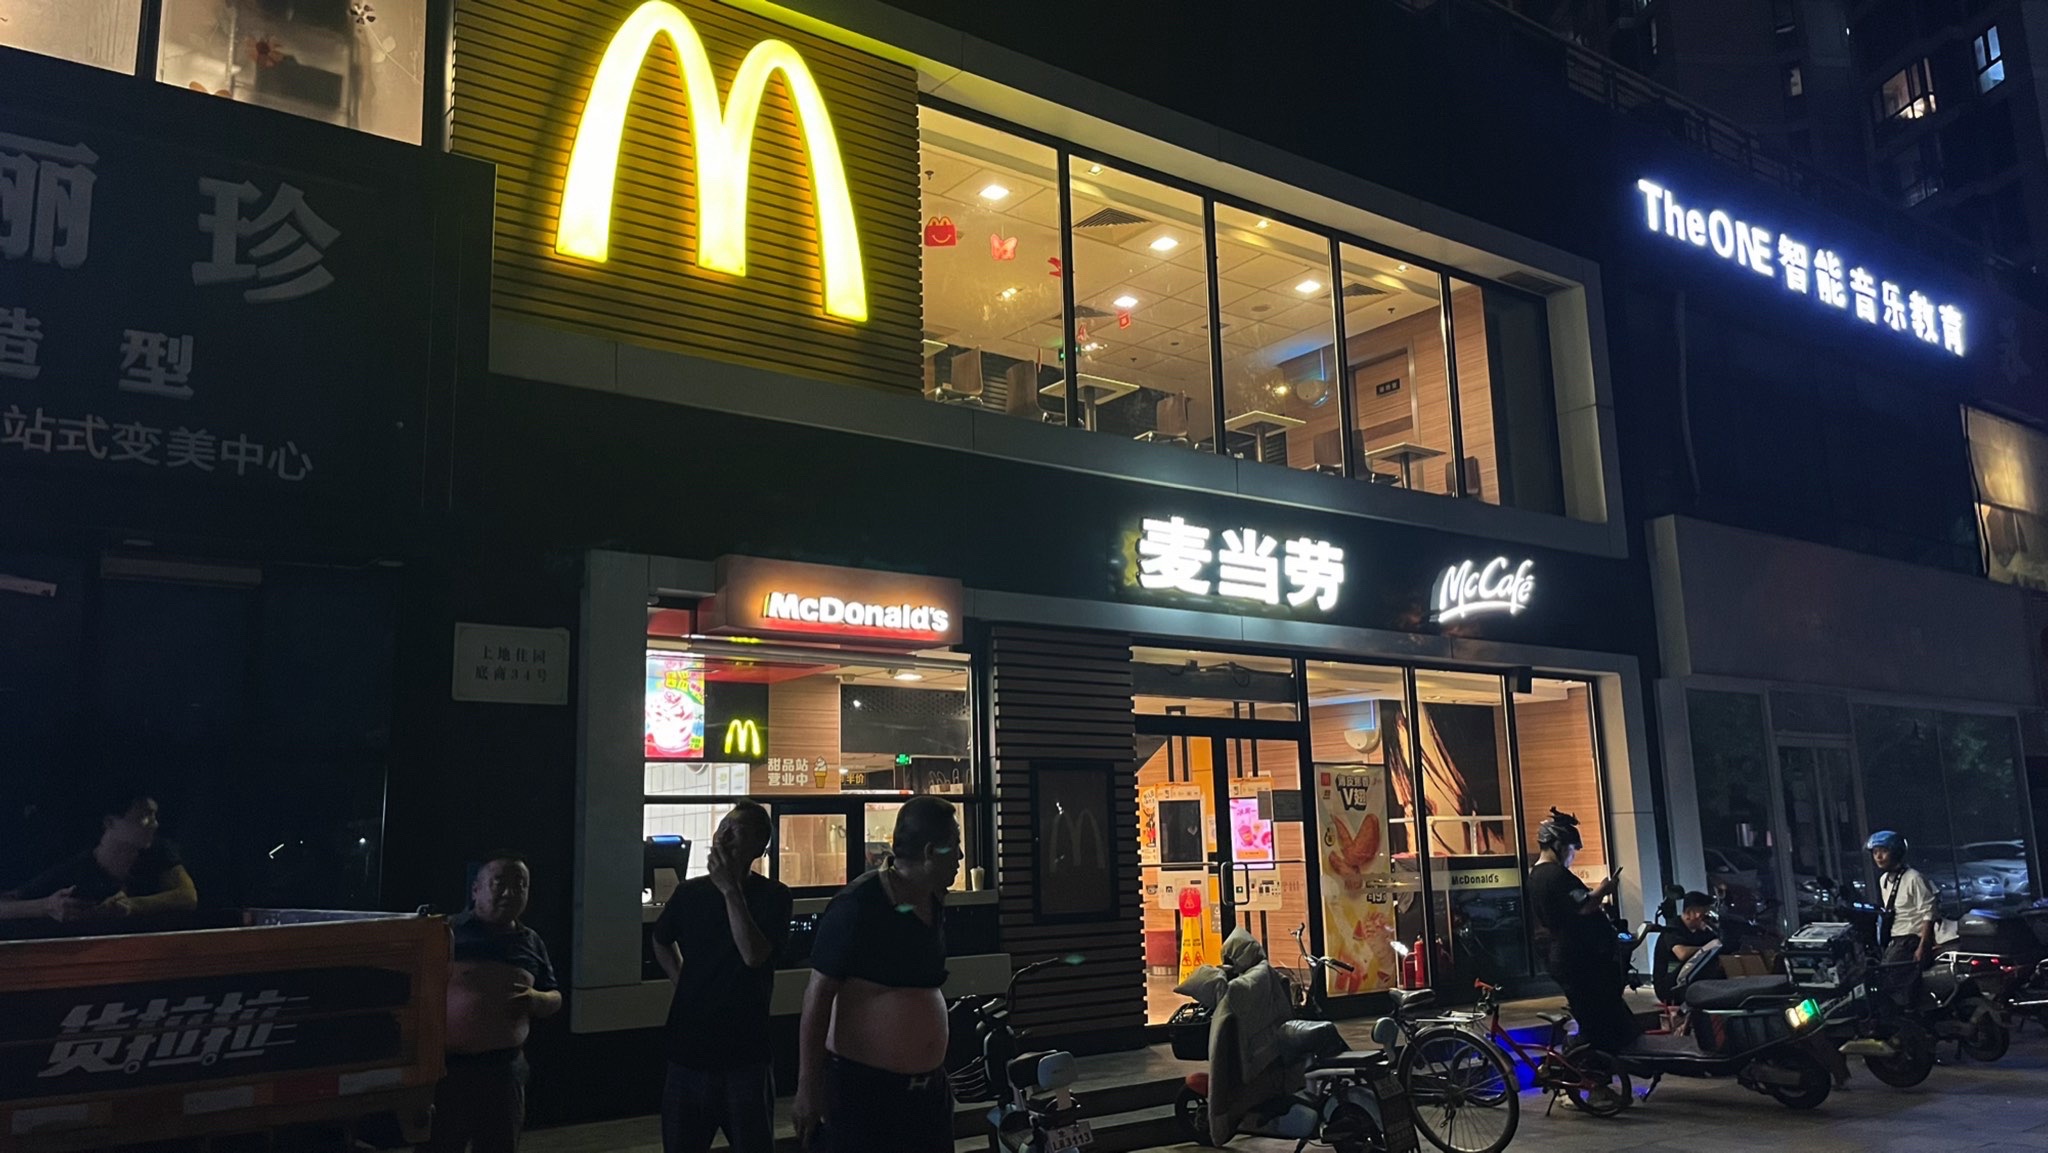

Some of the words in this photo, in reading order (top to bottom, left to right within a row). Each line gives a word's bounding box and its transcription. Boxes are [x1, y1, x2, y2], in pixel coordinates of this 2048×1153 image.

[1637, 178, 1775, 277] TheONE
[1777, 233, 1966, 357] 智能音乐教育
[1, 404, 314, 482] 站式变美中心
[1138, 516, 1345, 611] 麦当劳
[1438, 556, 1535, 618] McCafé
[765, 591, 949, 633] McDonald's
[767, 757, 809, 772] 甜品站
[767, 772, 809, 787] 营业中
[1451, 873, 1499, 885] McDonald's
[38, 989, 300, 1077] 货拉拉
